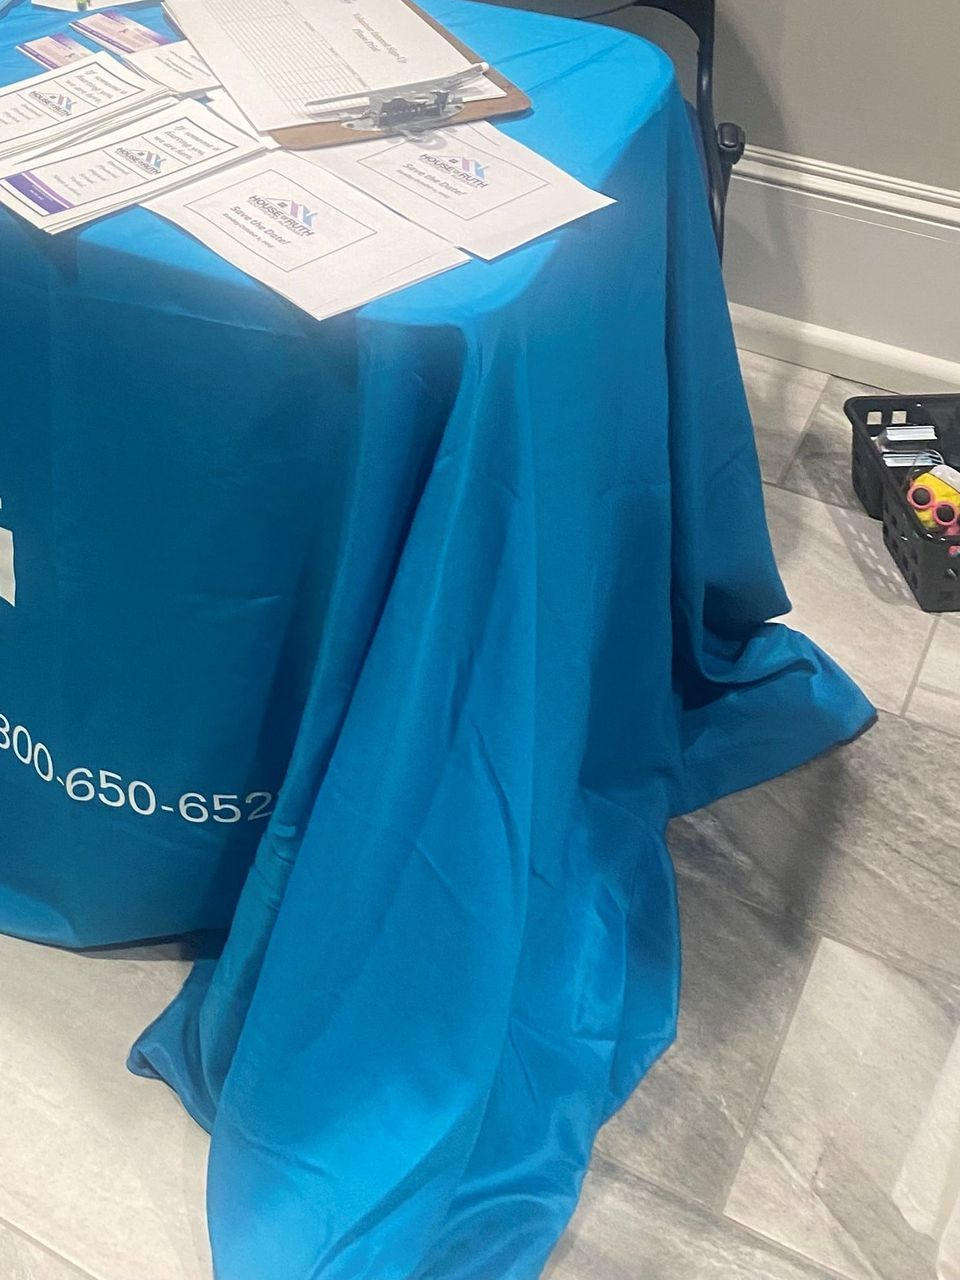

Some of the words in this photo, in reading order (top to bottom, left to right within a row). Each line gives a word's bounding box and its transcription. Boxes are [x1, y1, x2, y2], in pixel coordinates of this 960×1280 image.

[420, 153, 455, 172] HOUSE
[459, 172, 489, 188] RUTH
[230, 206, 252, 221] Save
[250, 219, 266, 230] the
[249, 194, 283, 218] HOUSE
[286, 218, 315, 237] RUTH
